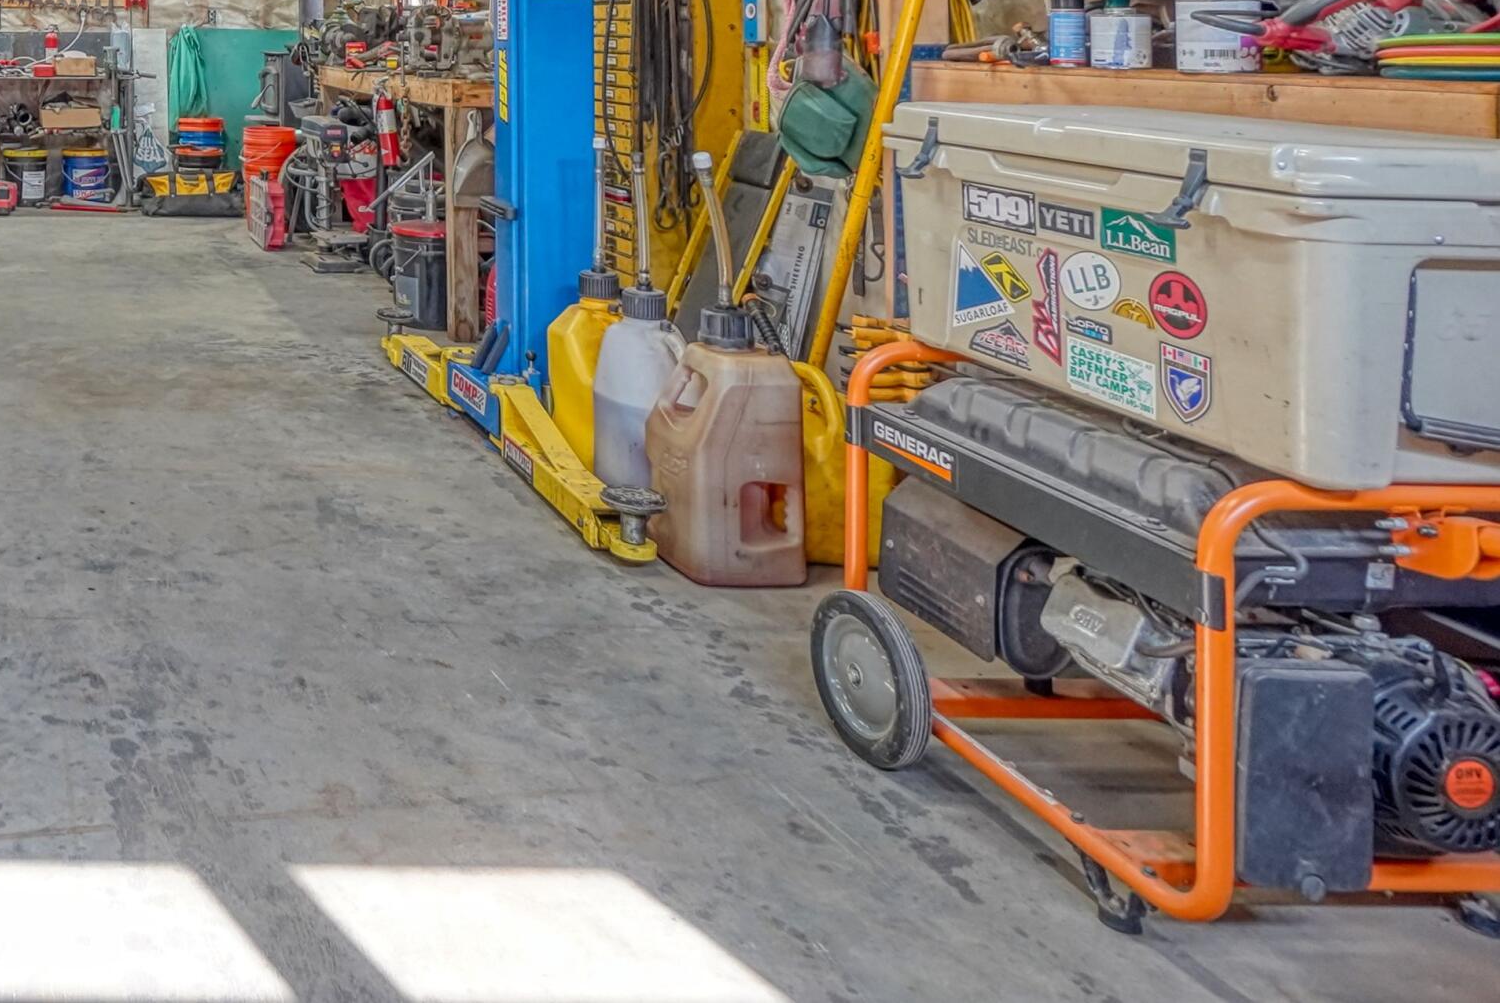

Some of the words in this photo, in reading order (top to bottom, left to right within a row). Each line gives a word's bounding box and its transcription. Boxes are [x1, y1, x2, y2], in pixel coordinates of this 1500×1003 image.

[498, 48, 509, 124] JEGS
[968, 187, 1031, 226] 509
[1040, 206, 1091, 236] YETI
[789, 245, 806, 290] SHEETING
[1067, 263, 1111, 294] LLB
[954, 302, 1009, 324] SUGARLOAF
[1153, 303, 1202, 323] MAGPUL
[1070, 345, 1126, 371] CASEY'S
[1070, 355, 1128, 384] SPENCER
[453, 372, 478, 398] COMP
[1070, 366, 1093, 381] BAY
[1095, 374, 1136, 399] CAMPS
[873, 420, 952, 470] GENERAC
